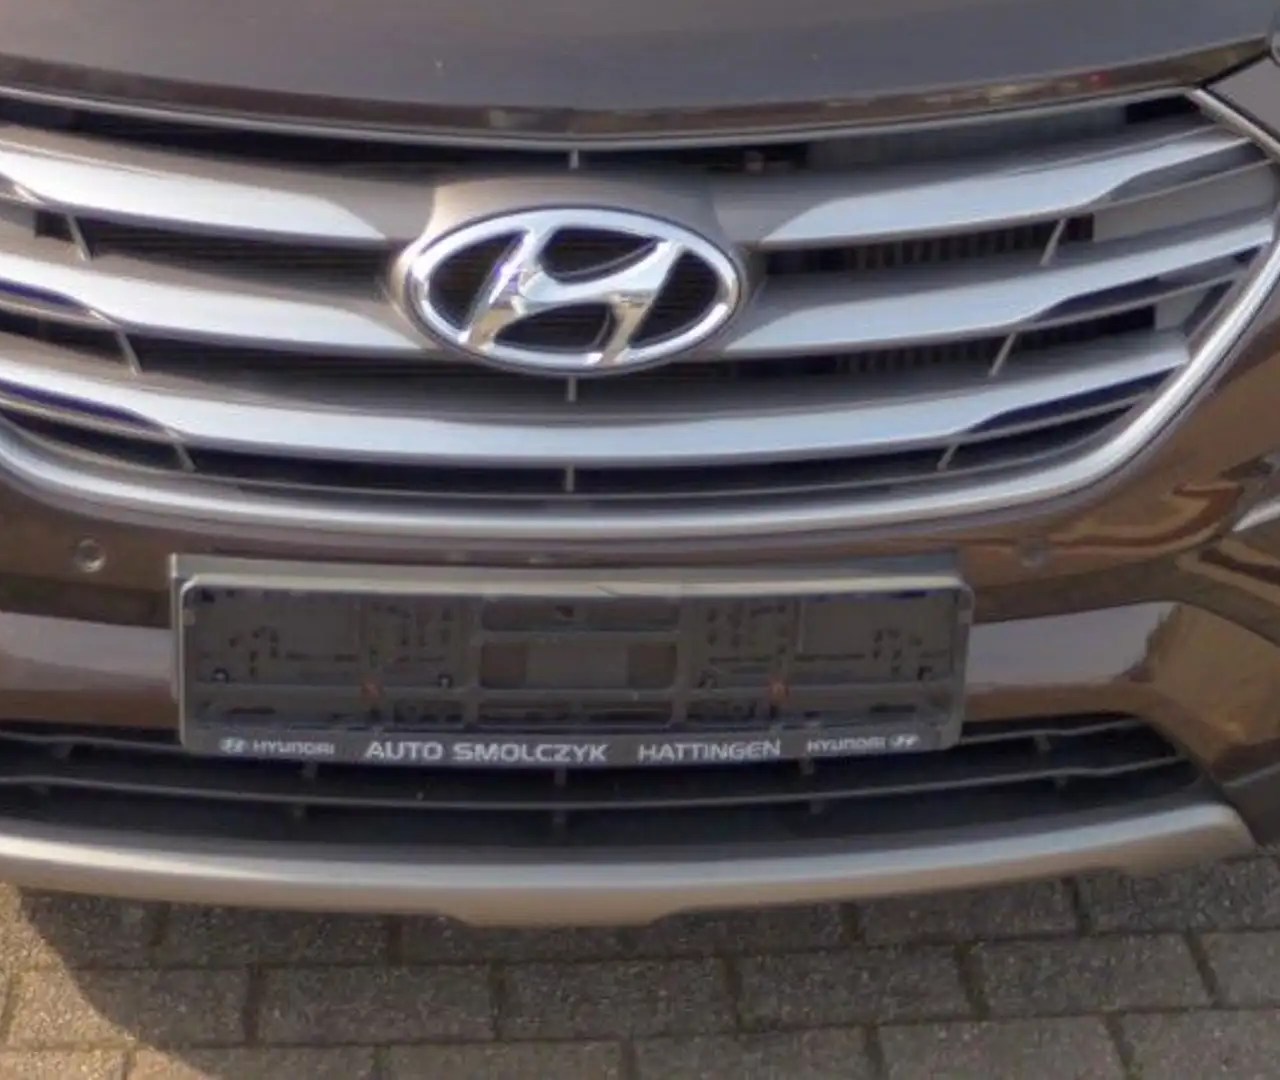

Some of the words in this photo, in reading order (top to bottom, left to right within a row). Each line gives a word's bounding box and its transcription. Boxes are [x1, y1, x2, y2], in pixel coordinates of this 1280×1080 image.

[365, 740, 443, 761] AUTO
[452, 743, 608, 762] SMOLCZYK
[637, 739, 781, 762] HATTINGEN
